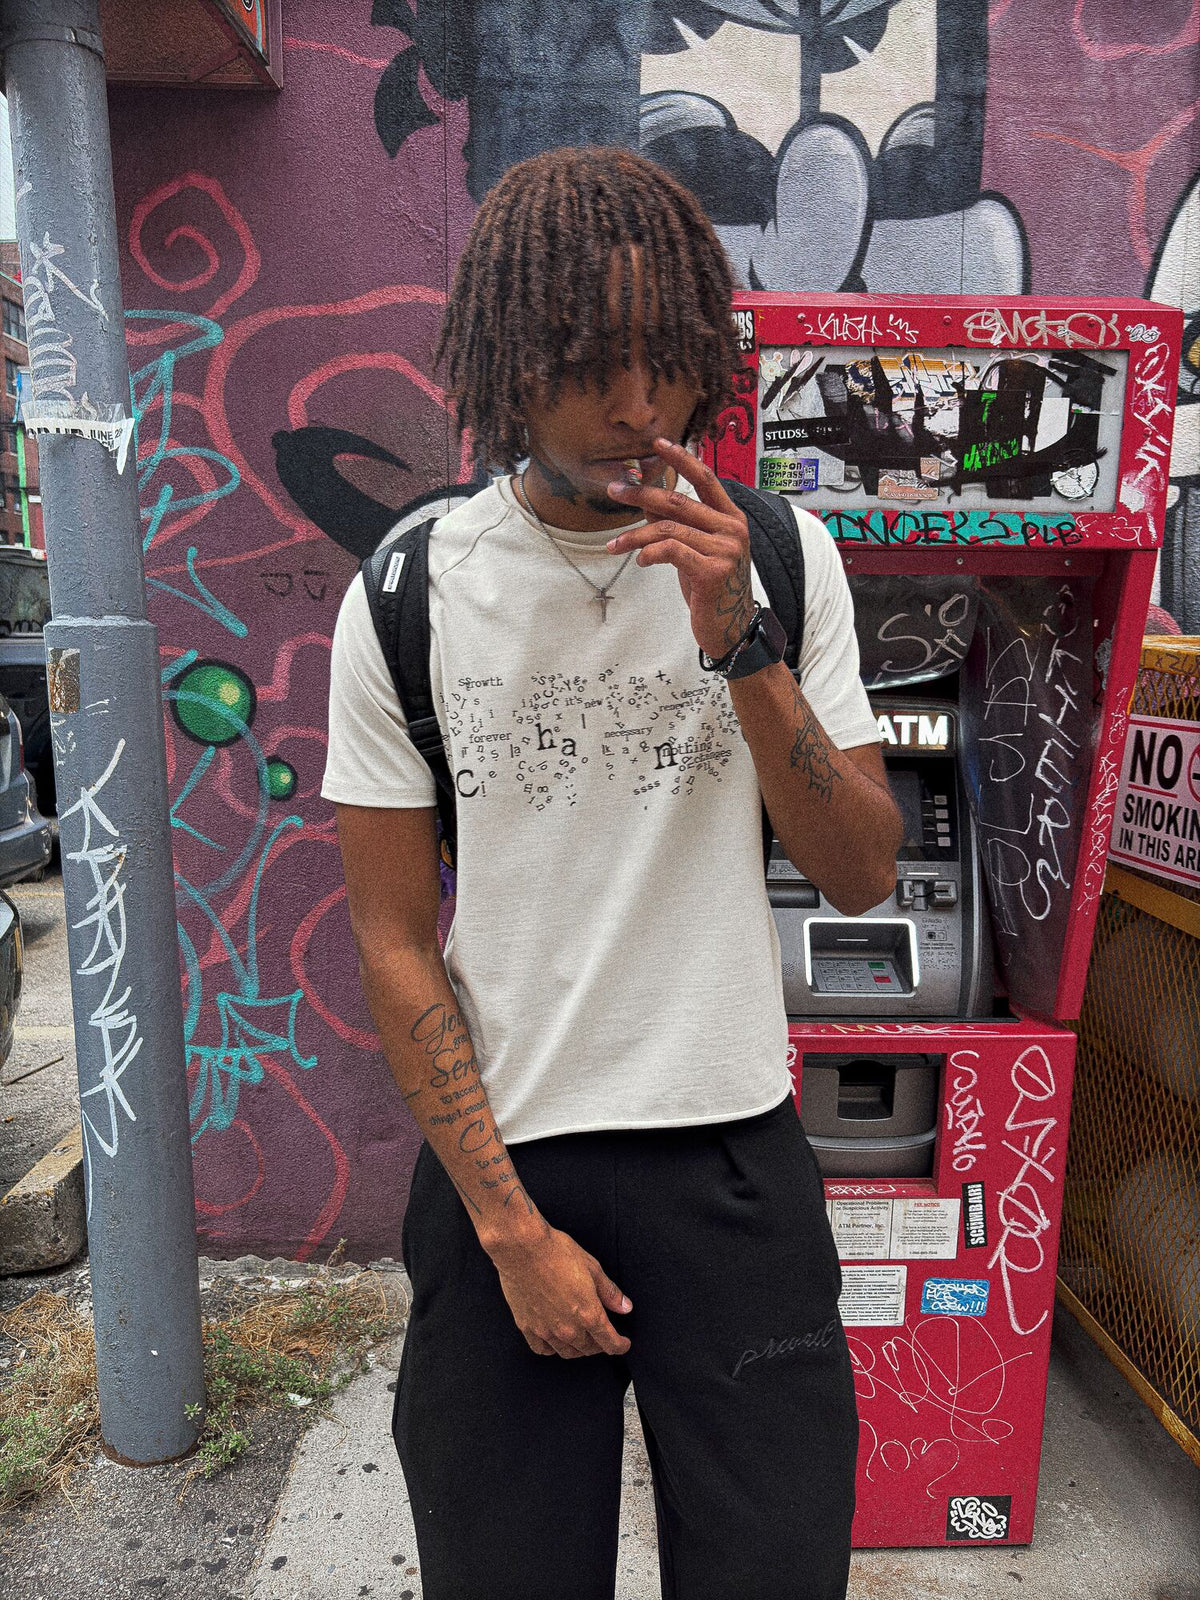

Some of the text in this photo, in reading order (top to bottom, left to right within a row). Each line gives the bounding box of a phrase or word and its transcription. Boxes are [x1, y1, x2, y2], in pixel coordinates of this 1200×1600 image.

[469, 732, 513, 744] forever
[604, 727, 653, 739] necessary
[877, 715, 948, 745] ATM
[1129, 730, 1183, 790] NO
[1119, 827, 1134, 851] IN
[1138, 832, 1171, 862] THIS
